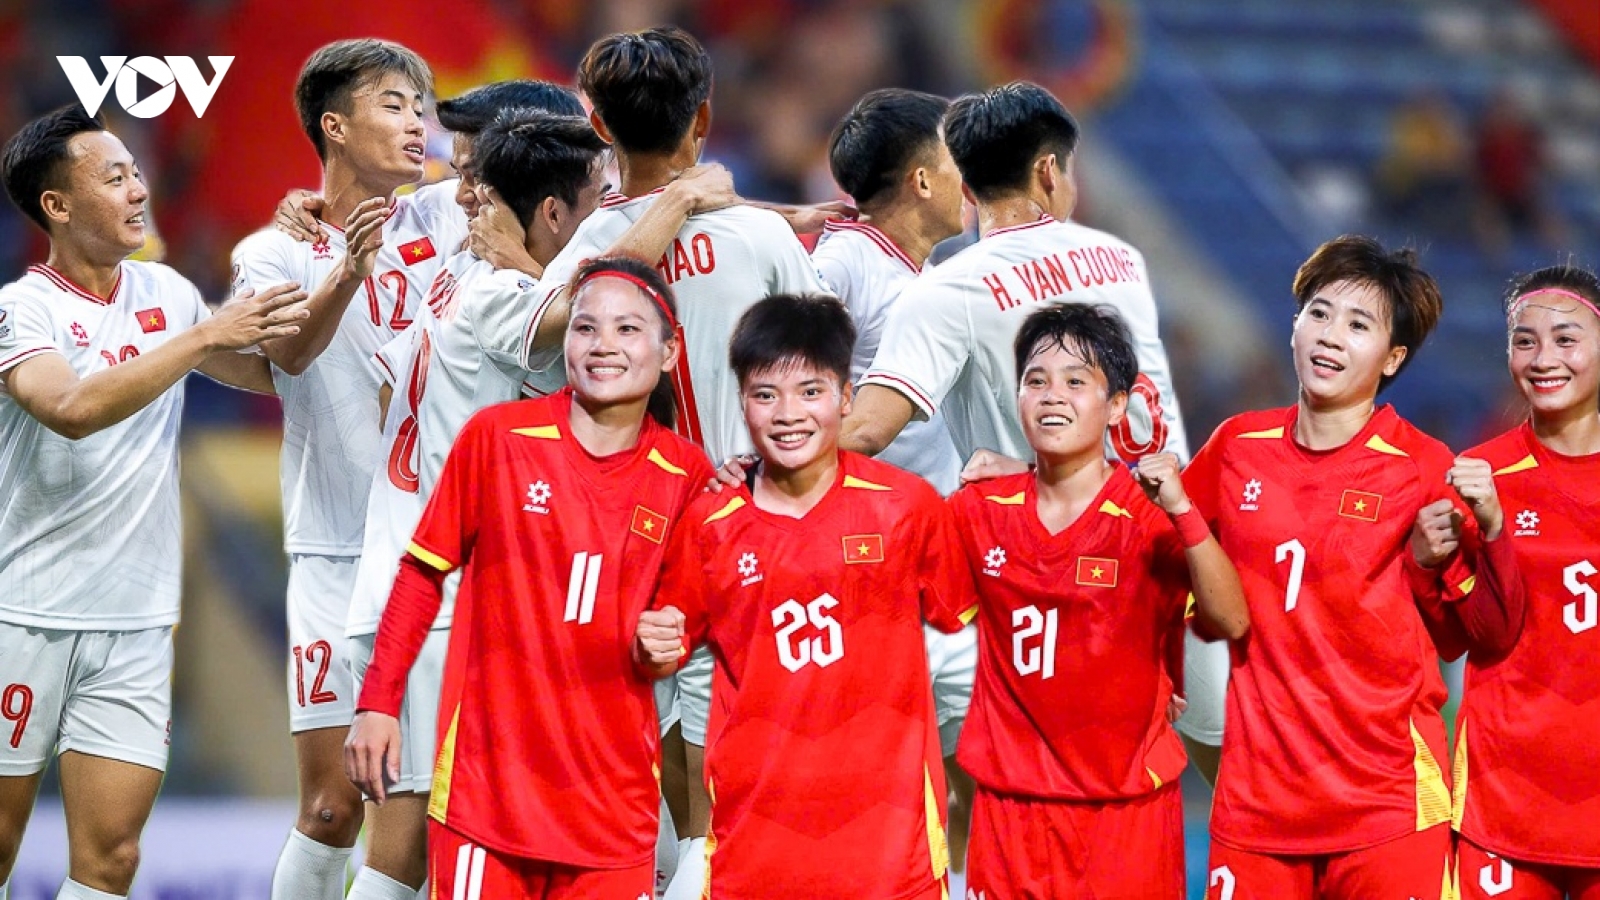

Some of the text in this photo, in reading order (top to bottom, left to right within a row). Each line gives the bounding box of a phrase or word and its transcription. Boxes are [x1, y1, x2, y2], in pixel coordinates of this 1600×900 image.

[364, 268, 414, 331] 12
[982, 272, 1022, 312] H.
[1012, 252, 1073, 302] VAN
[563, 551, 603, 625] 11
[1274, 538, 1307, 613] 7
[1562, 559, 1598, 634] 5
[771, 592, 845, 674] 25
[1011, 604, 1059, 681] 21
[293, 640, 338, 708] 12
[1, 683, 34, 748] 9
[453, 843, 487, 900] 11
